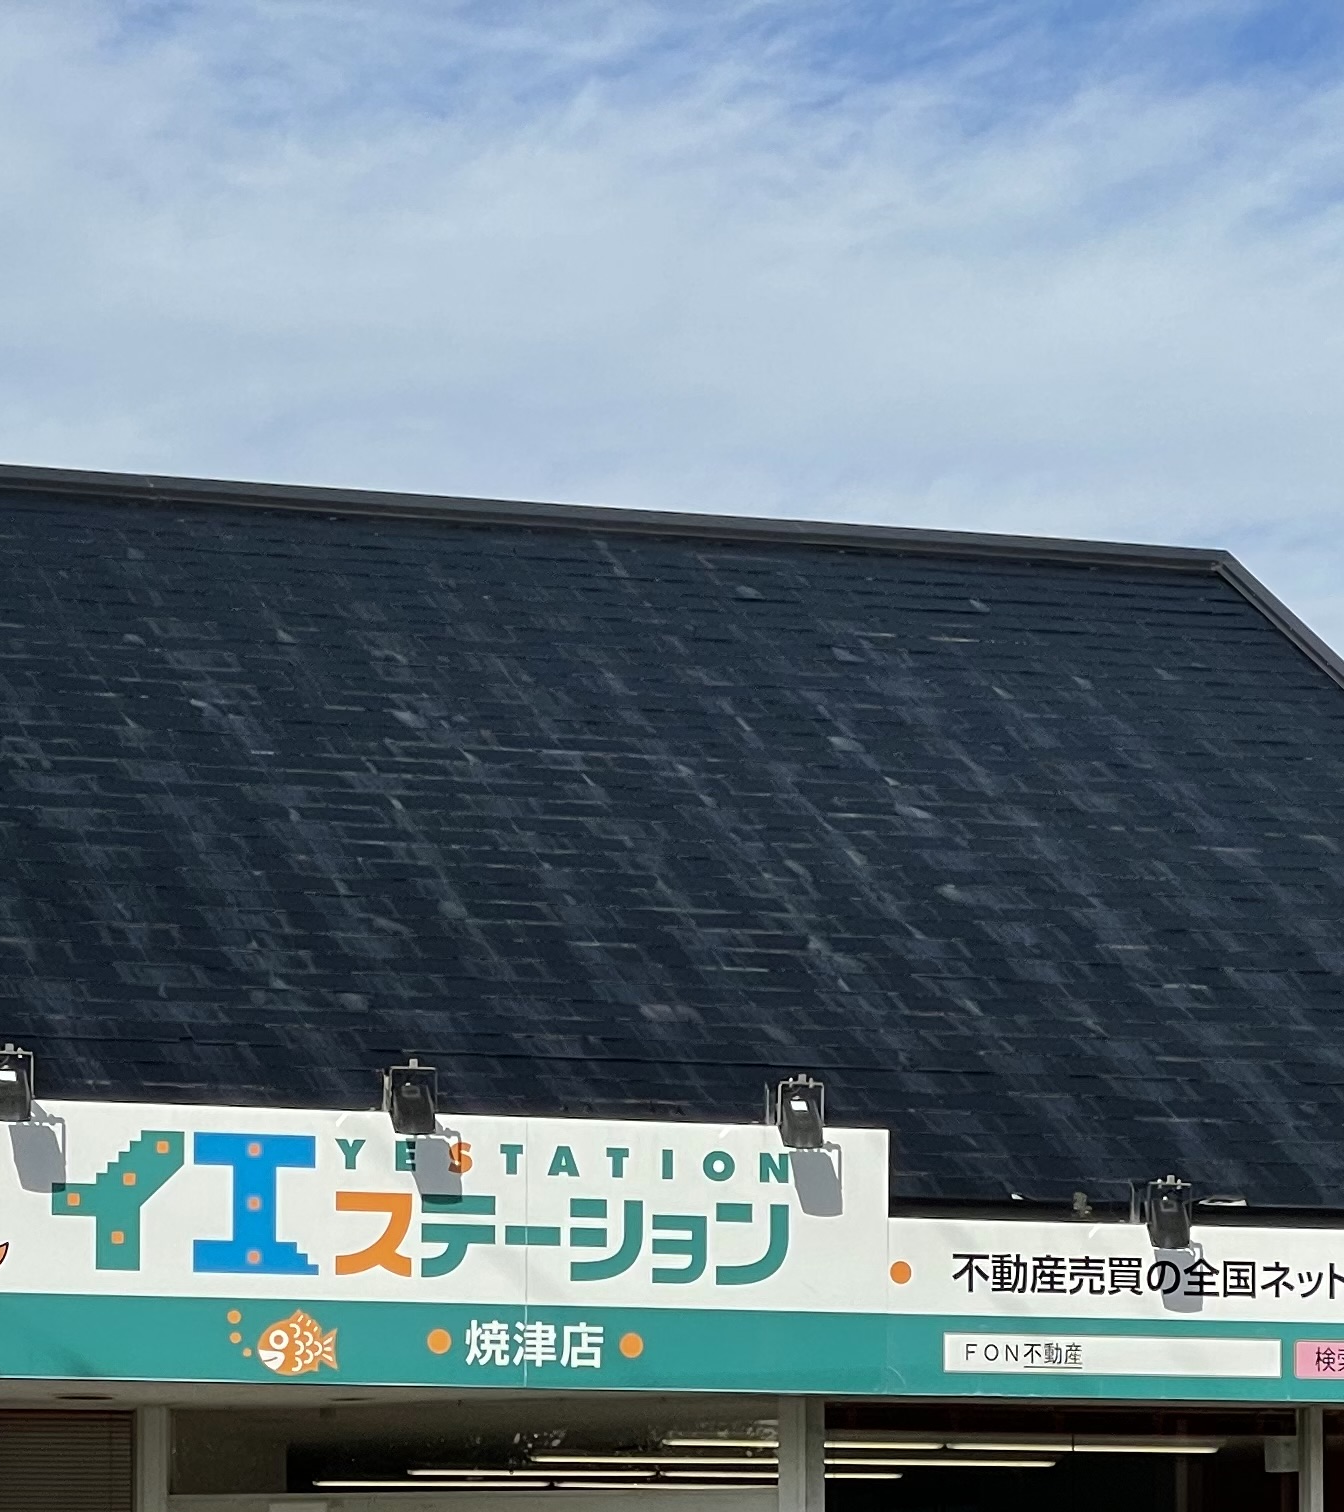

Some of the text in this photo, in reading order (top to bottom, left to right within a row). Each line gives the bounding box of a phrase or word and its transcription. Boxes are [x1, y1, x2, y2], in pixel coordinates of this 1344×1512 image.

[335, 1138, 789, 1183] YESTATION
[52, 1129, 789, 1286] イエステーション
[464, 1319, 605, 1369] 焼津店
[964, 1342, 1083, 1365] FON不動産
